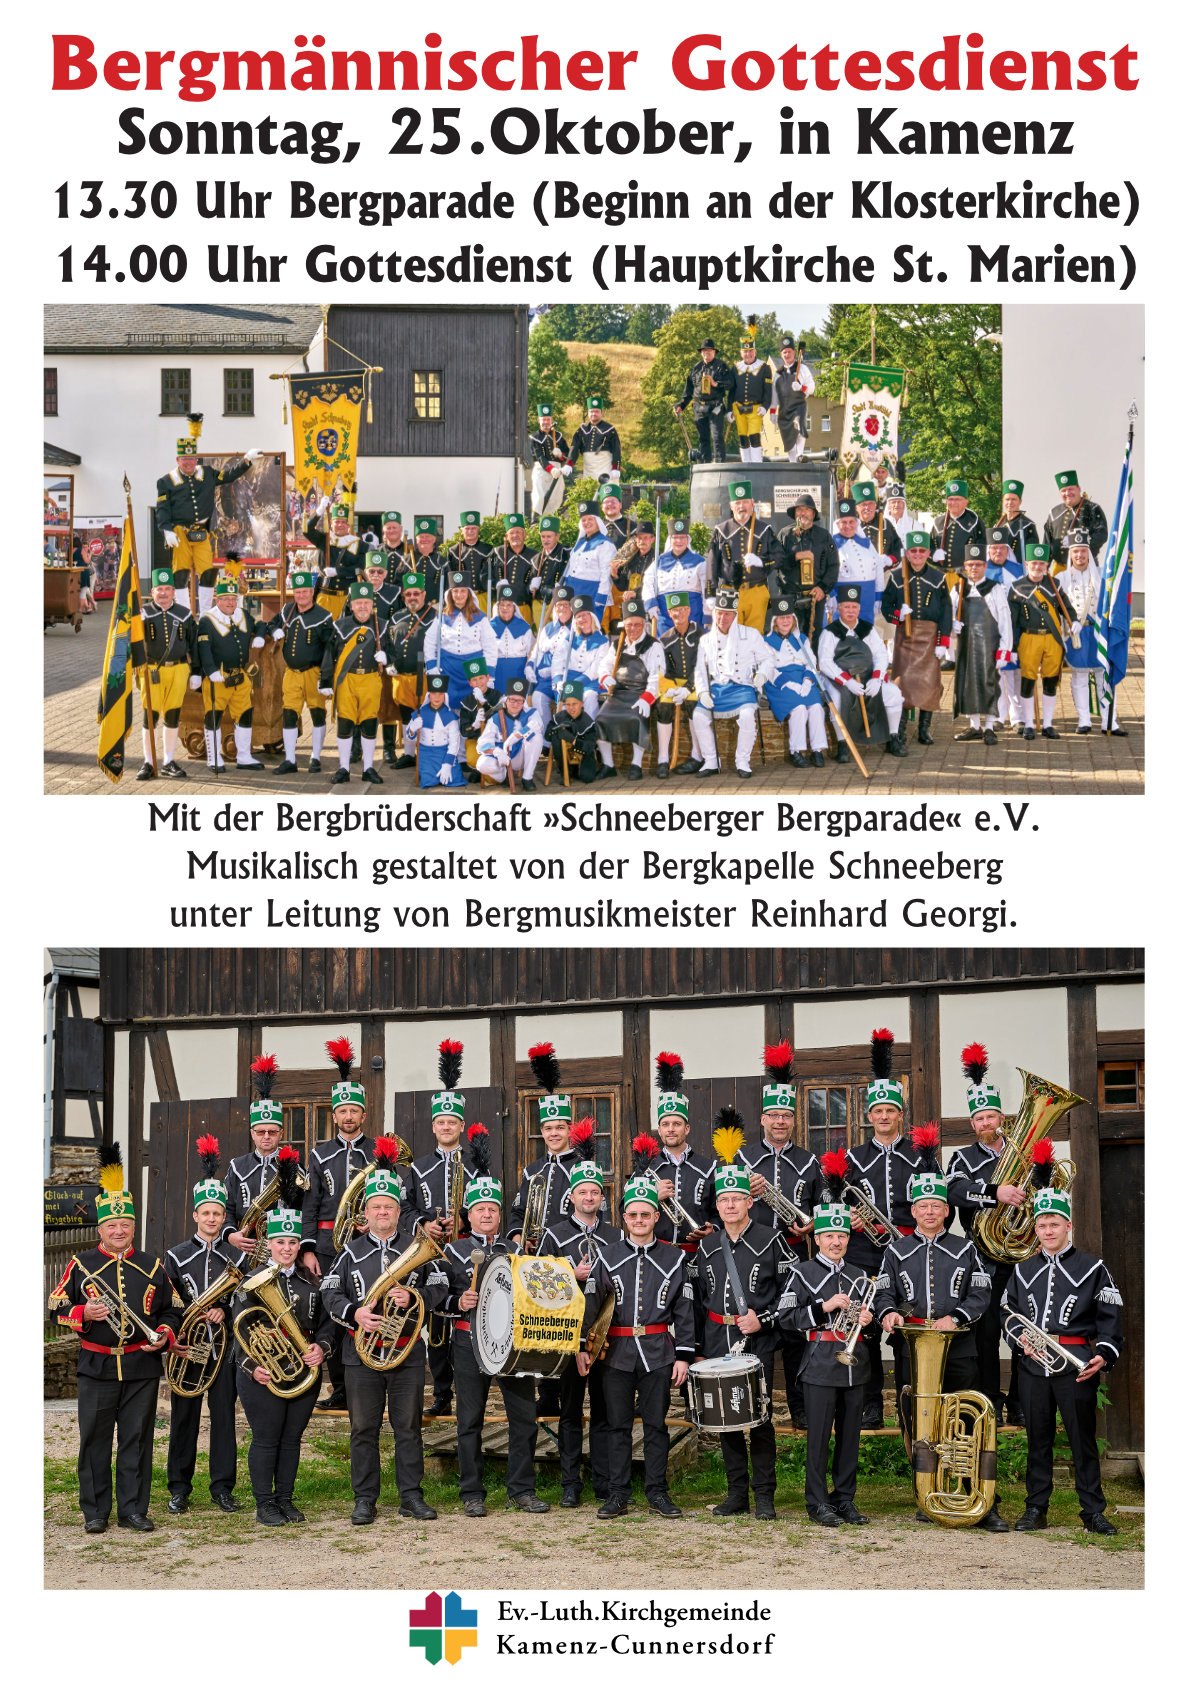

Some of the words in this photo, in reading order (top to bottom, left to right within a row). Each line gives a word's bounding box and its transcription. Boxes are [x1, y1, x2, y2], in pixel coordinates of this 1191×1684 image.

[52, 33, 638, 102] Bergmännischer
[672, 33, 1139, 91] Gottesdienst
[119, 107, 360, 164] Sonntag,
[388, 107, 752, 163] 25.Oktober,
[780, 106, 830, 154] in
[857, 108, 1074, 155] Kamenz
[55, 181, 177, 218] 13.30
[197, 181, 272, 219] Uhr
[291, 181, 514, 226] Bergparade
[533, 180, 689, 226] (Beginn
[707, 192, 751, 218] an
[769, 181, 833, 218] der
[852, 180, 1139, 226] Klosterkirche)
[58, 245, 187, 283] 14.00
[208, 245, 287, 282] Uhr
[306, 244, 572, 282] Gottesdienst
[593, 244, 874, 290] (Hauptkirche
[894, 245, 947, 282] St.
[967, 244, 1136, 290] Marien)
[148, 803, 201, 831] Mit
[214, 803, 263, 831] der
[277, 803, 531, 837] Bergbrüderschaft
[544, 803, 764, 837] »Schneeberger
[778, 803, 961, 837] Bergparade«
[975, 803, 1039, 831] e.V.
[187, 851, 357, 879] Musikalisch
[373, 851, 497, 885] gestaltet
[510, 859, 564, 879] von
[580, 851, 629, 879] der
[644, 851, 814, 885] Bergkapelle
[830, 851, 1003, 885] Schneeberg
[171, 904, 252, 927] unter
[268, 899, 381, 933] Leitung
[393, 907, 449, 927] von
[466, 899, 736, 933] Bergmusikmeister
[752, 899, 886, 927] Reinhard
[903, 899, 1016, 933] Georgi.
[519, 1313, 579, 1328] Schneeberger
[522, 1327, 574, 1341] Bergkapelle
[498, 1600, 771, 1627] Ev.-Luth.Kirchgemeinde
[497, 1633, 775, 1654] Kamenz-Cunnersdorf
